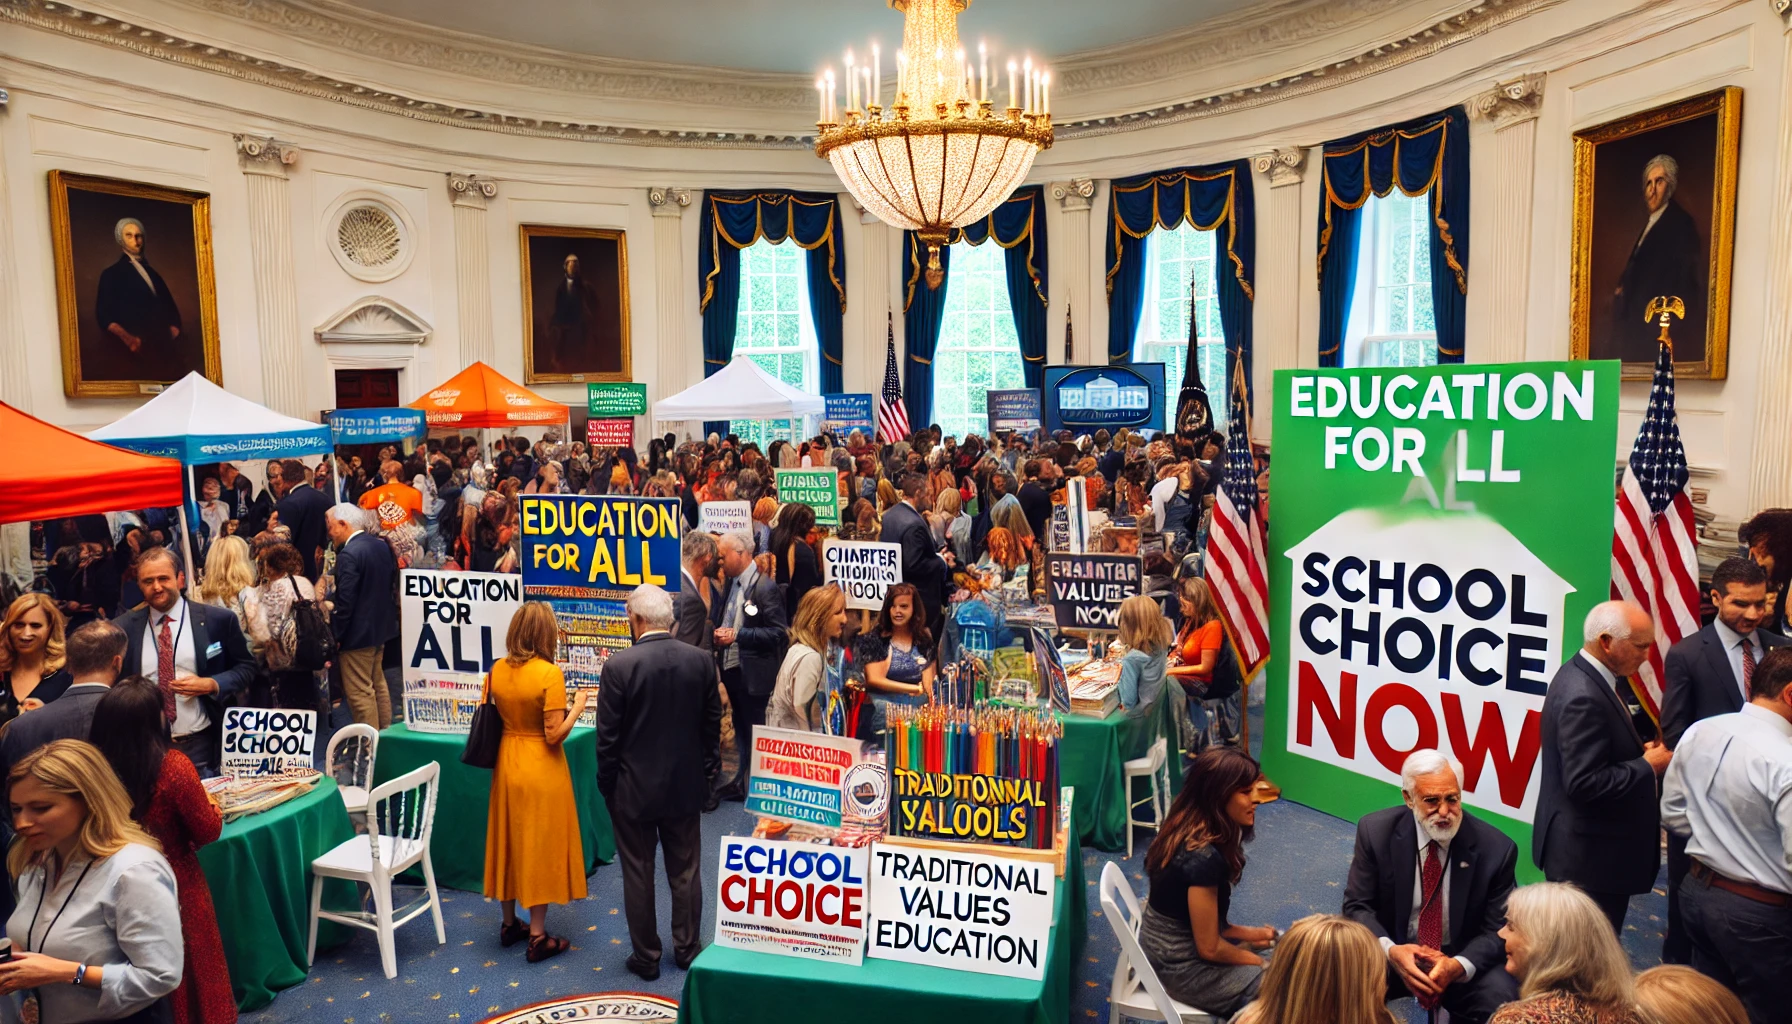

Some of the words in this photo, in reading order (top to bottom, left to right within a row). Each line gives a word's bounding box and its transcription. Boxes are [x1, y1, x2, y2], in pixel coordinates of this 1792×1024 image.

[1290, 370, 1594, 422] EDUCATION
[1324, 426, 1425, 476] FOR
[522, 499, 678, 539] EDUCATION
[533, 543, 580, 573] FOR
[588, 537, 667, 586] ALL
[405, 574, 519, 602] EDUCATION
[1301, 552, 1547, 628] SCHOOL
[423, 601, 472, 625] FOR
[1299, 603, 1547, 696] CHOICE
[224, 710, 313, 735] SCHOOL
[224, 732, 311, 755] SCHOOL
[1296, 660, 1542, 809] NOW
[725, 843, 862, 884] ECHOOL
[876, 851, 1048, 896] TRADITIONAL
[721, 874, 863, 929] CHOICE
[899, 886, 1011, 927] VALUES
[876, 919, 1038, 969] EDUCATION
